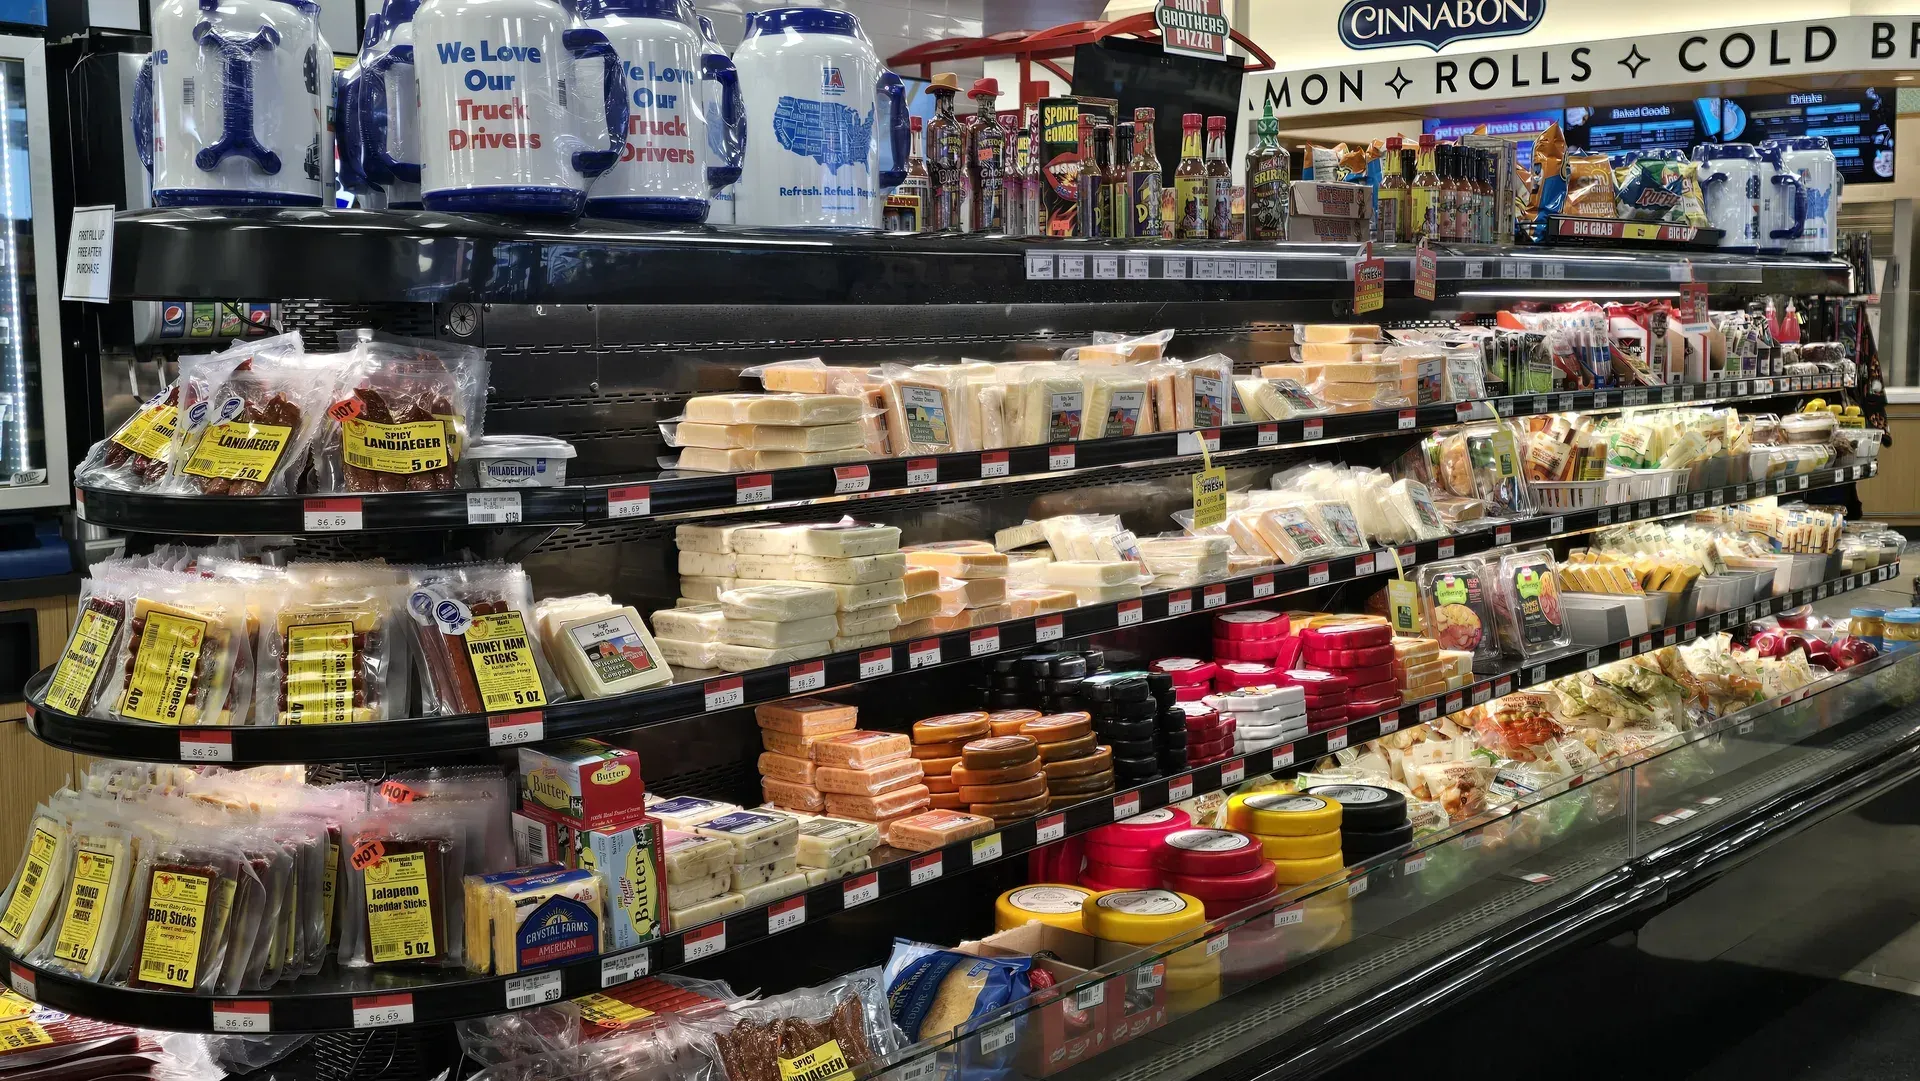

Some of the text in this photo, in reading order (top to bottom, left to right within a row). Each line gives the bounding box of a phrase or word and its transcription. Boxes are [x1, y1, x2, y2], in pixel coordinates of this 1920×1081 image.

[1162, 8, 1225, 34] BROTHERS
[1351, 0, 1528, 40] CINNABON
[1176, 27, 1213, 49] PIZZA
[436, 39, 542, 65] We Love
[1436, 47, 1592, 94] ROLLS
[1678, 25, 1838, 72] COLD
[464, 69, 516, 92] Our
[648, 61, 694, 86] Love
[633, 87, 677, 109] Our
[1790, 92, 1823, 105] Drinks
[457, 96, 529, 121] Truck
[1044, 105, 1078, 127] SPONTA
[1612, 105, 1671, 119] Baked Goods
[628, 114, 689, 137] Truck
[1487, 122, 1518, 134] treats
[1520, 121, 1535, 131] on
[449, 126, 542, 151] Drivers
[620, 141, 695, 164] Drivers
[822, 152, 842, 164] TEXAS
[780, 186, 856, 197] Refresh. Refuel.
[78, 229, 89, 241] FIRST
[98, 229, 105, 241] UP
[1573, 222, 1613, 236] BIG GRAB
[1668, 227, 1680, 239] BIG
[77, 246, 102, 258] FREE AFTER
[76, 262, 100, 274] PURCHASE
[1364, 270, 1382, 281] FRESH
[331, 401, 355, 420] HOT
[384, 430, 411, 440] SPICY
[218, 434, 280, 452] LANDJAEGER
[364, 436, 441, 451] LANDJAEGER
[238, 466, 246, 477] 5
[411, 459, 421, 471] 5
[487, 465, 536, 477] PHILADELPHIA
[1203, 480, 1224, 494] FRESH
[619, 505, 641, 515] $8.69
[317, 518, 347, 527] $6.69
[485, 614, 508, 622] Wisconsin
[592, 627, 621, 639] Swiss Cheese
[597, 622, 609, 630] Aged
[470, 637, 526, 654] HONEY HAM
[482, 651, 519, 666] STICKS
[594, 655, 627, 669] Wisconsin
[602, 662, 626, 673] Cheese
[602, 667, 633, 680] Company
[166, 650, 196, 719] Sau-Cheese
[65, 692, 74, 706] 5
[513, 690, 524, 705] 5
[501, 730, 529, 742] $6.69
[192, 748, 219, 757] $6.29
[596, 768, 626, 783] Butter
[383, 783, 410, 801] HOT
[532, 774, 570, 801] Butter
[353, 842, 379, 868] HOT
[388, 855, 411, 863] Wisconsin
[75, 884, 99, 900] SMOKED
[372, 885, 420, 901] Jalapeno
[581, 888, 589, 896] 16
[619, 876, 632, 908] Prairie
[635, 856, 649, 925] Butter
[75, 897, 94, 910] STRING
[153, 901, 197, 912] Sweet Baby Dave's
[368, 898, 428, 913] Cheddar Sticks
[72, 909, 92, 922] CHEESE
[148, 908, 197, 928] BBQ Sticks
[526, 921, 589, 945] CRYSTAL FARMS
[71, 943, 80, 958] 5
[404, 941, 413, 956] 5
[538, 939, 577, 956] AMERICAN
[693, 943, 714, 955] $9.29
[166, 964, 175, 980] 5
[904, 962, 931, 992] FARMS
[545, 987, 559, 1001] $5.19
[905, 960, 950, 1036] HEDDAR CHEESE
[225, 1019, 254, 1028] $6.69
[369, 1012, 399, 1023] $6.69
[792, 1052, 816, 1070] SPICY
